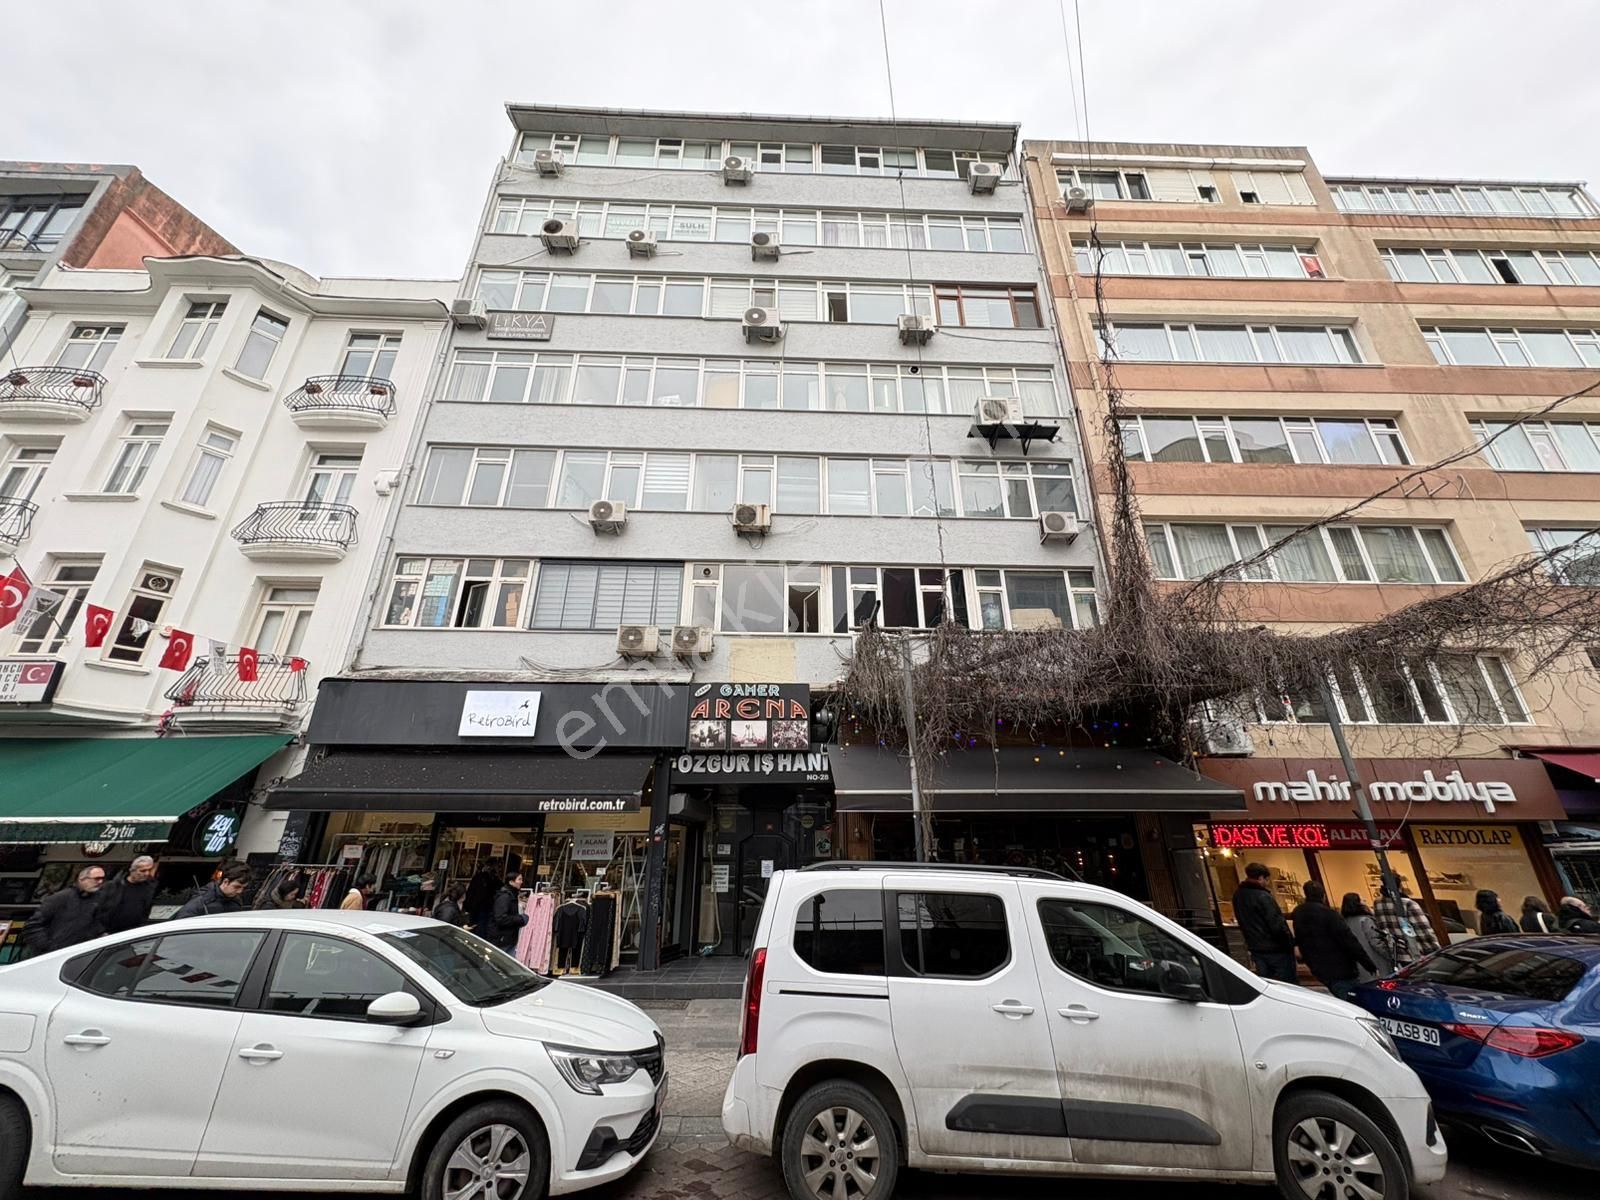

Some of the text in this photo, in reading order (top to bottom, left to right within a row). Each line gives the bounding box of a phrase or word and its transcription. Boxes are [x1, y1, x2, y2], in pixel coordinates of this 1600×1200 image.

[719, 684, 780, 697] GAMER
[690, 698, 808, 719] ARENA
[1252, 768, 1518, 813] mahir mobilya
[538, 798, 626, 812] retrobird.com.tr
[99, 823, 137, 841] Zeytin
[1263, 827, 1289, 844] VE
[1420, 829, 1513, 845] RAYDOLAP
[1396, 1022, 1421, 1040] ASB
[1423, 1028, 1439, 1044] 90
